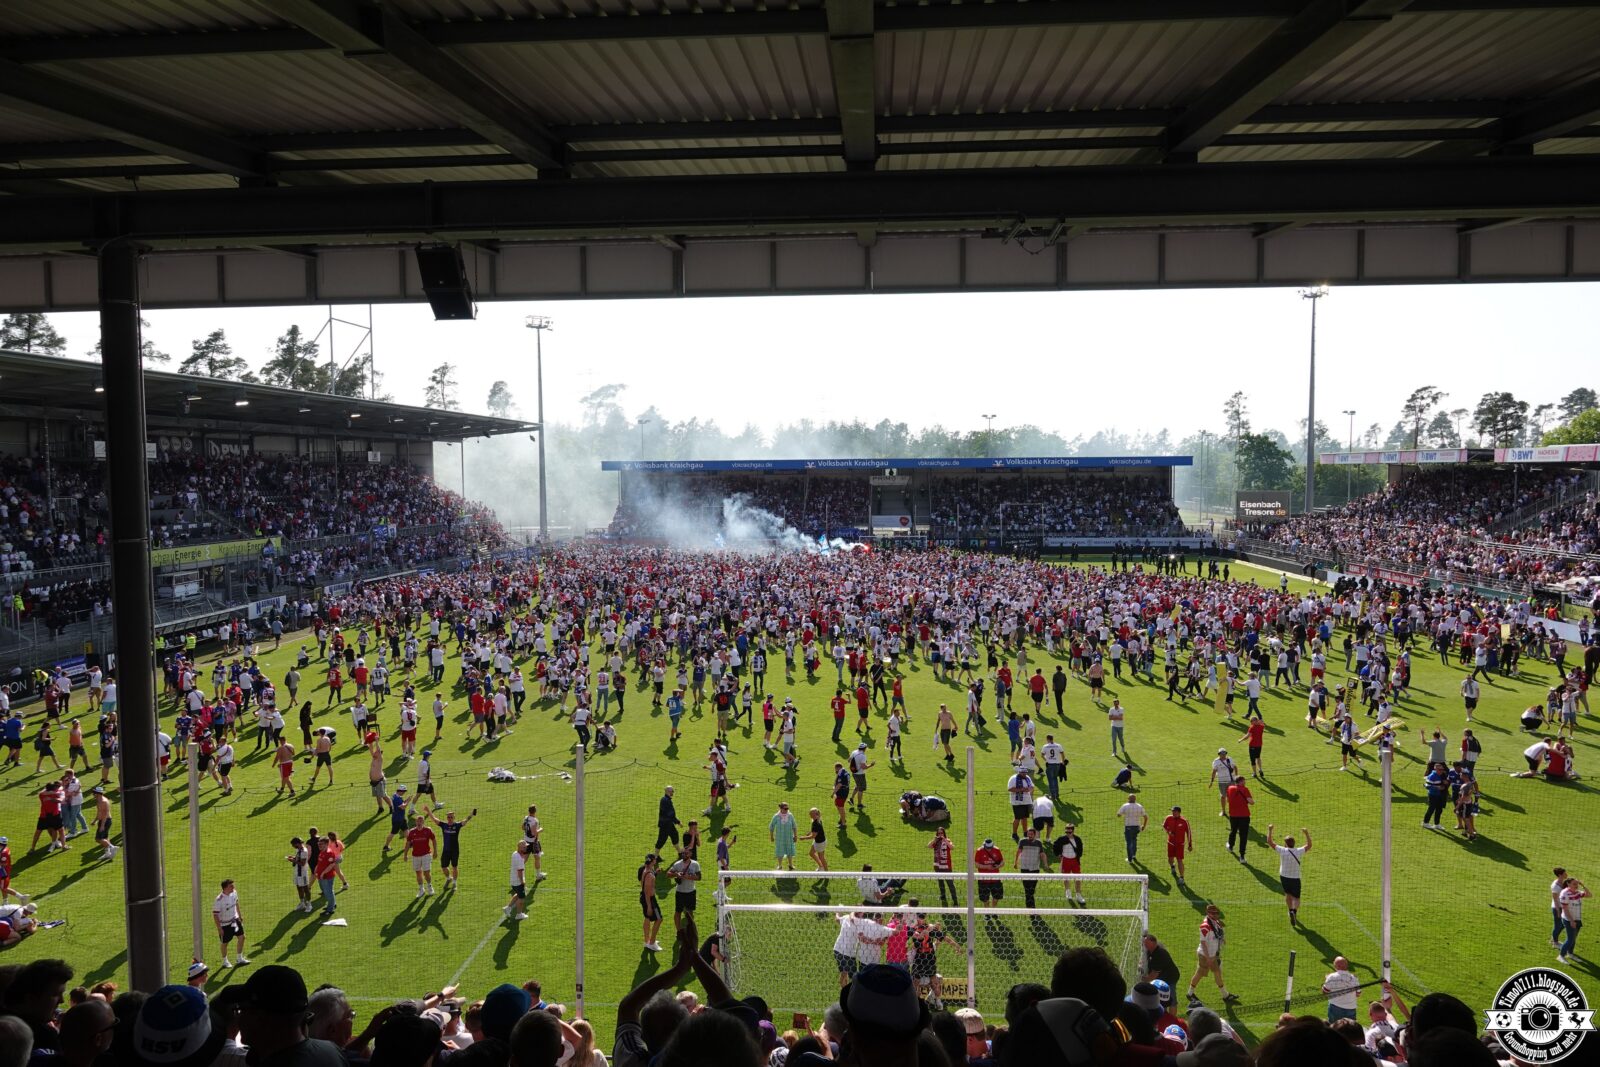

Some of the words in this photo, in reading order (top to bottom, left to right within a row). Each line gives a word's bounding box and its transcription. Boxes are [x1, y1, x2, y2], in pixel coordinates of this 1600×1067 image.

[1517, 450, 1534, 460] BWT
[670, 462, 704, 470] Kraichgau
[853, 460, 889, 468] Kraichgau
[1043, 459, 1079, 467] Kraichgau
[1244, 508, 1286, 516] Tresore.de
